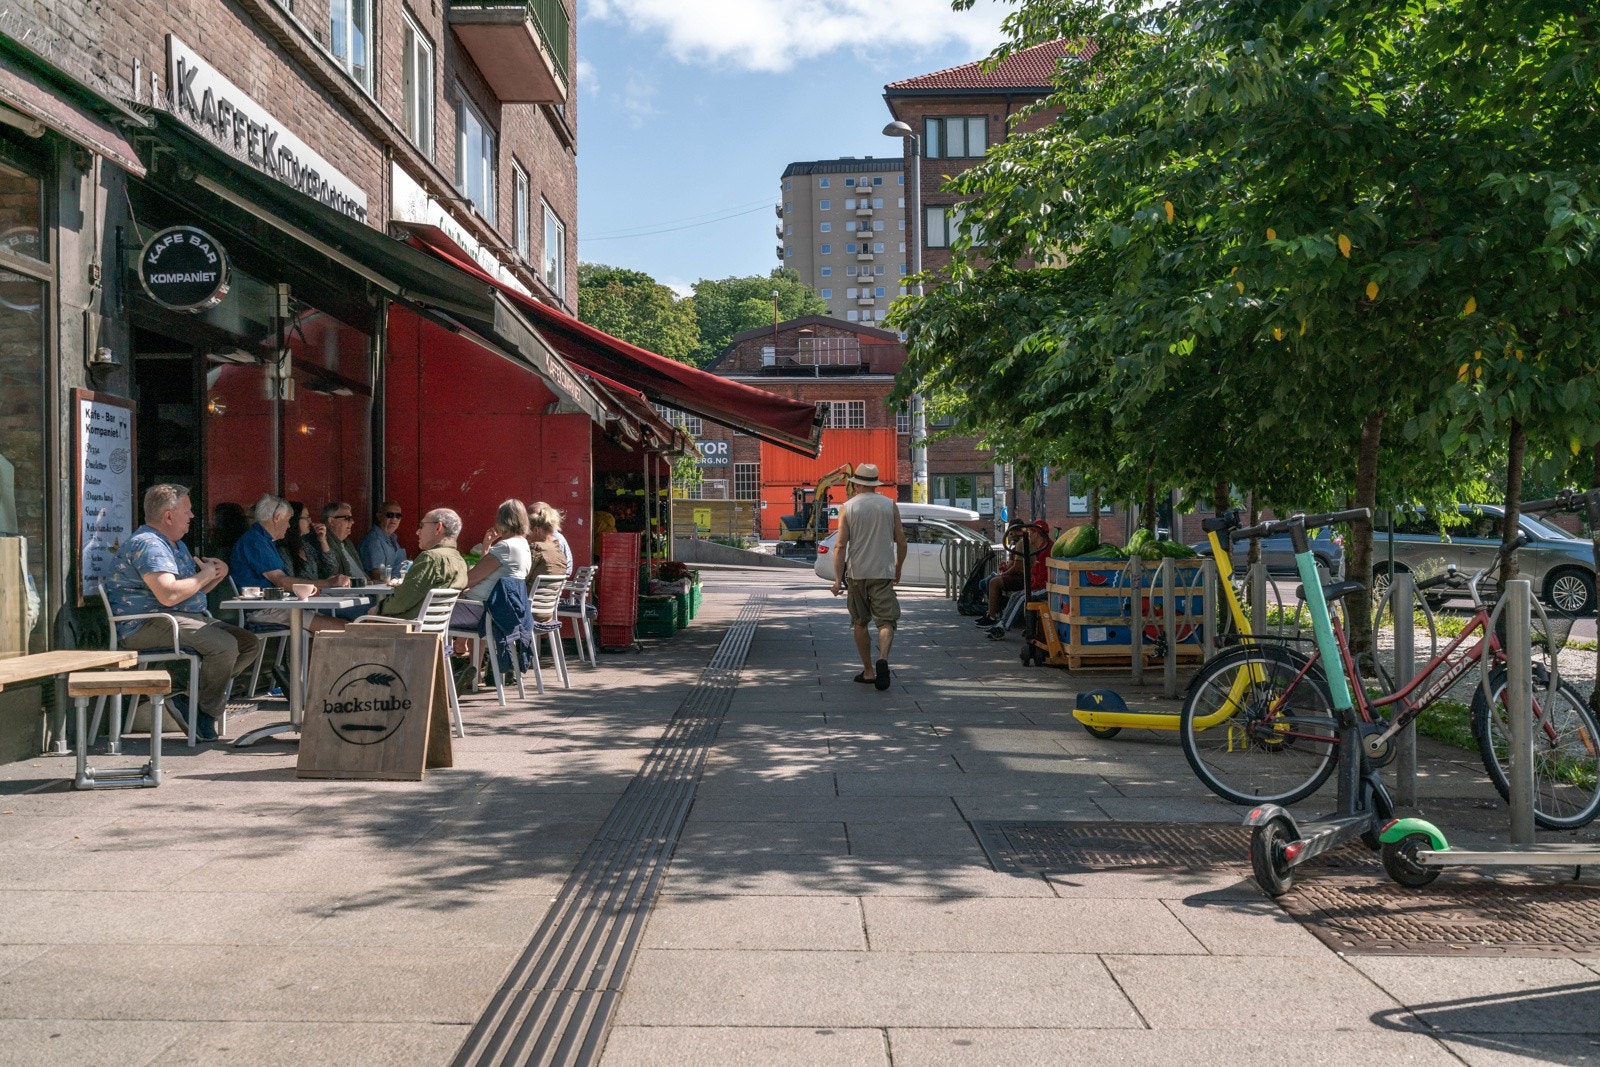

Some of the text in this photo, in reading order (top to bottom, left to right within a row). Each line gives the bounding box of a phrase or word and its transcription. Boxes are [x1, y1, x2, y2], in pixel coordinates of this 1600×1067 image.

[148, 234, 217, 264] KAFE BAR
[85, 408, 100, 420] Kafe
[105, 412, 116, 423] Bar
[85, 423, 119, 439] Kompaniet
[1418, 656, 1473, 709] MERIDA
[323, 695, 412, 714] backstube
